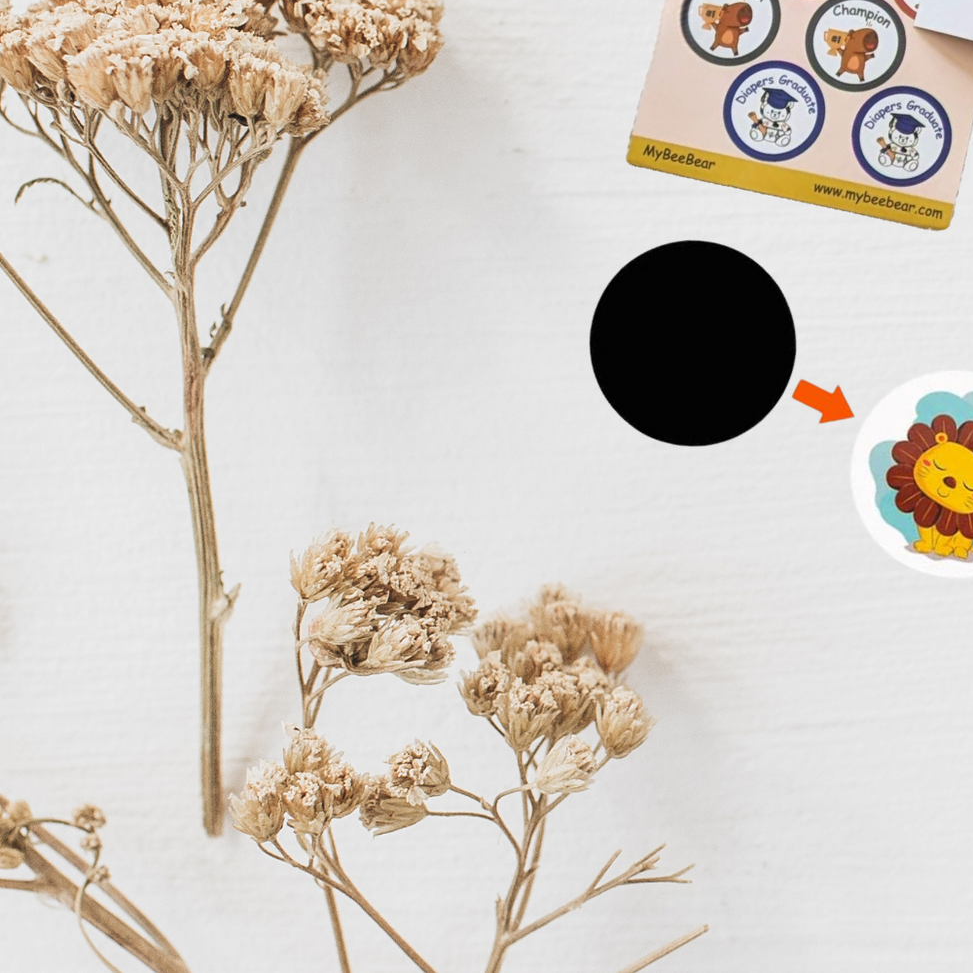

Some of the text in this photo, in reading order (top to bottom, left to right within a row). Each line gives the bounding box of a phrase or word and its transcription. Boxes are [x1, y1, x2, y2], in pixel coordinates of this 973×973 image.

[832, 4, 891, 29] Champion
[735, 75, 816, 115] Diapers Graduate
[864, 100, 943, 140] Diapers Graduate
[643, 145, 715, 170] MyBeeBear
[813, 182, 943, 220] www.mybeebear.com
